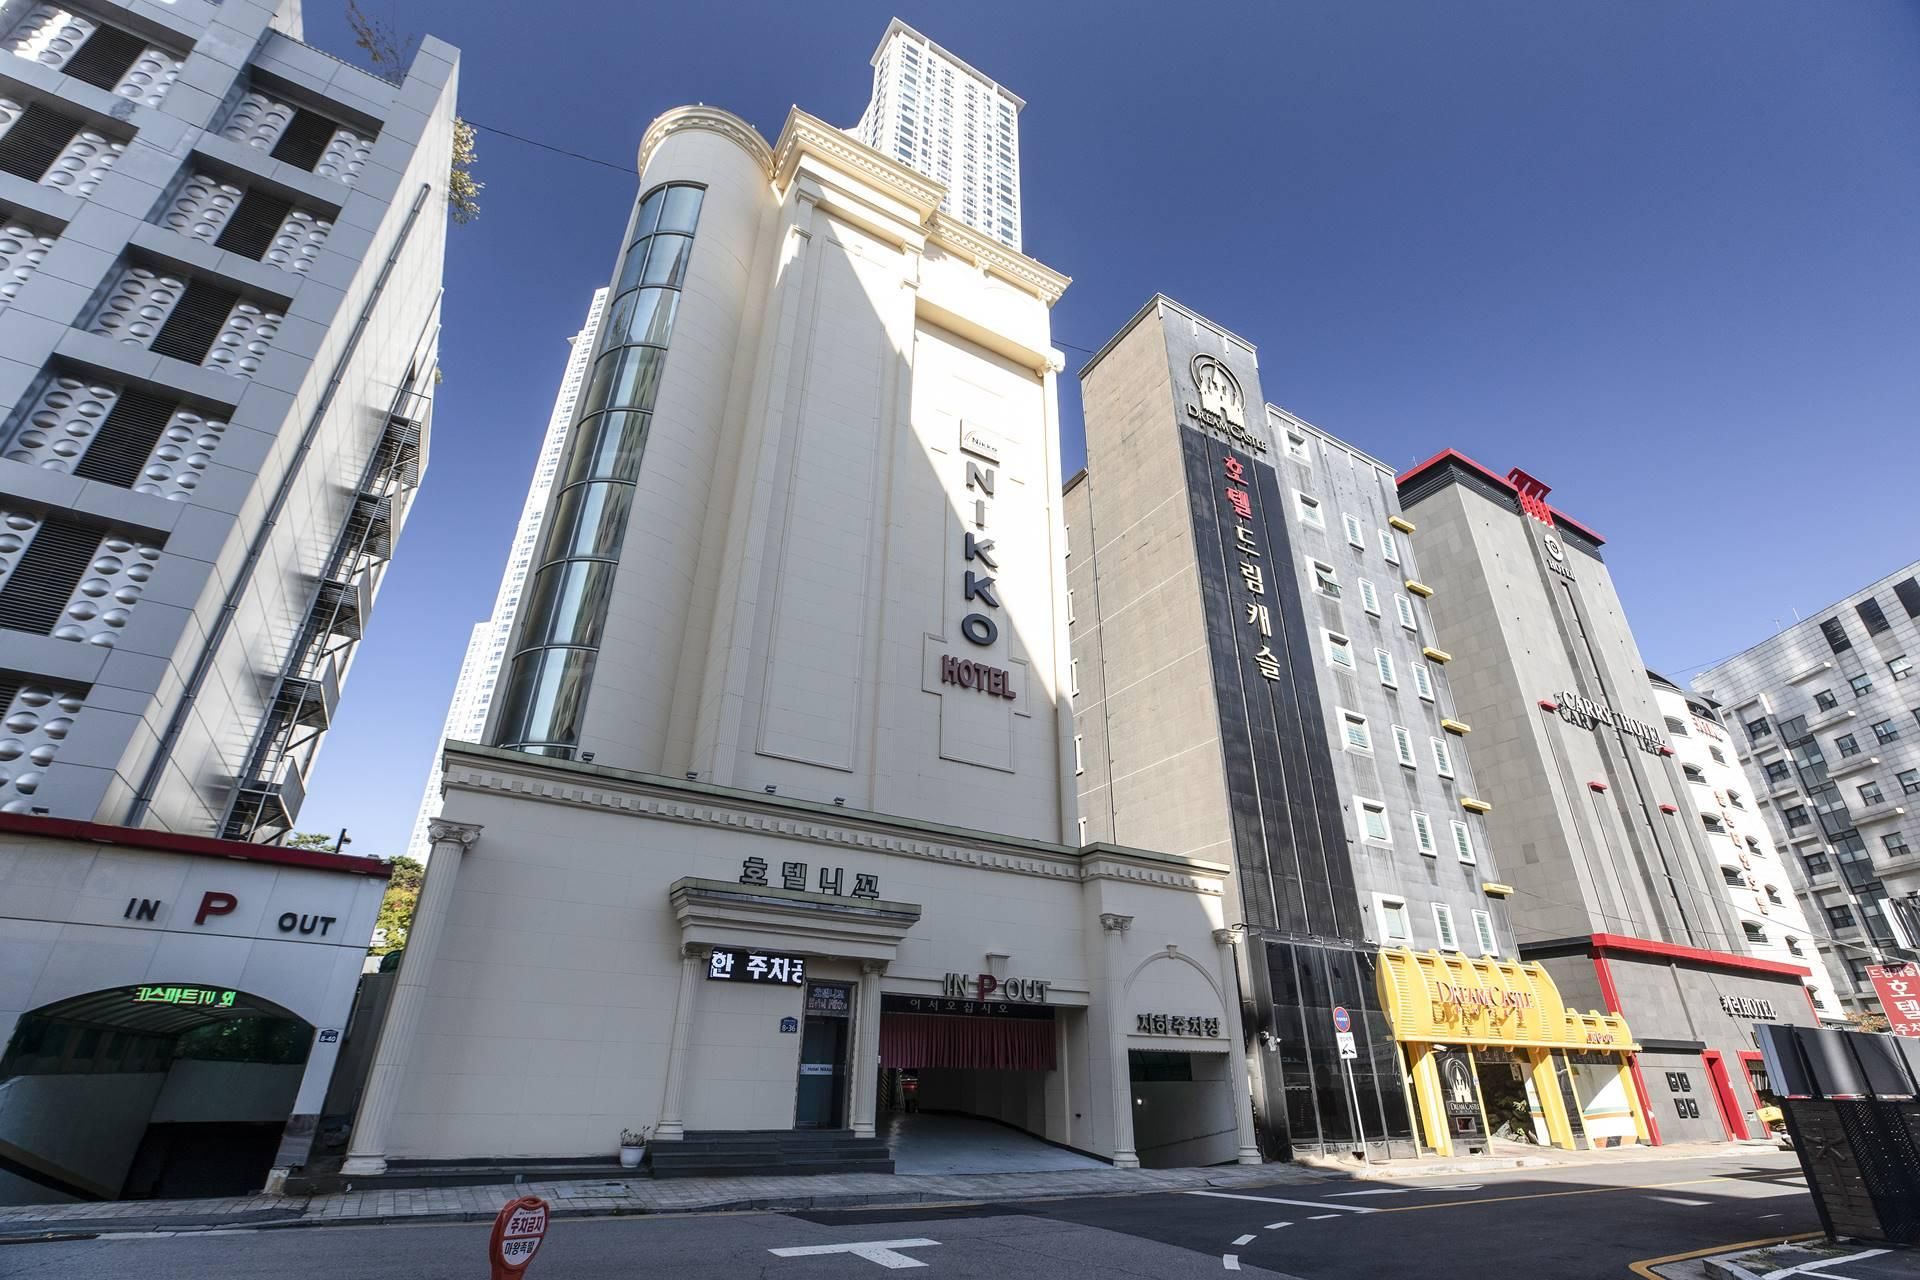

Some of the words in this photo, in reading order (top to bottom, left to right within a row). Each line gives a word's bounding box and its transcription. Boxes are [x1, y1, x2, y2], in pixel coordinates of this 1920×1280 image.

[1185, 402, 1231, 436] DREAM
[1230, 424, 1267, 454] CASTLE
[1222, 454, 1254, 520] 호텔
[961, 460, 999, 646] NIKKO
[1547, 559, 1576, 583] HOTEL
[1235, 523, 1281, 682] 드림캐슬
[941, 653, 1016, 700] HOTEL
[1560, 690, 1612, 727] CARRY
[1618, 712, 1665, 745] HOTEL
[739, 856, 879, 899] 호텔니꼬
[124, 898, 161, 921] IN
[194, 891, 238, 925] P
[278, 912, 336, 937] OUT
[943, 973, 969, 998] IN
[977, 974, 998, 1003] P
[1004, 978, 1052, 1003] OUT
[1436, 981, 1490, 1008] DREAM
[1489, 986, 1533, 1009] CASTLE
[1886, 980, 1920, 1020] 호텔
[1136, 1013, 1220, 1038] 지하주차장
[511, 1216, 544, 1233] 주차금지
